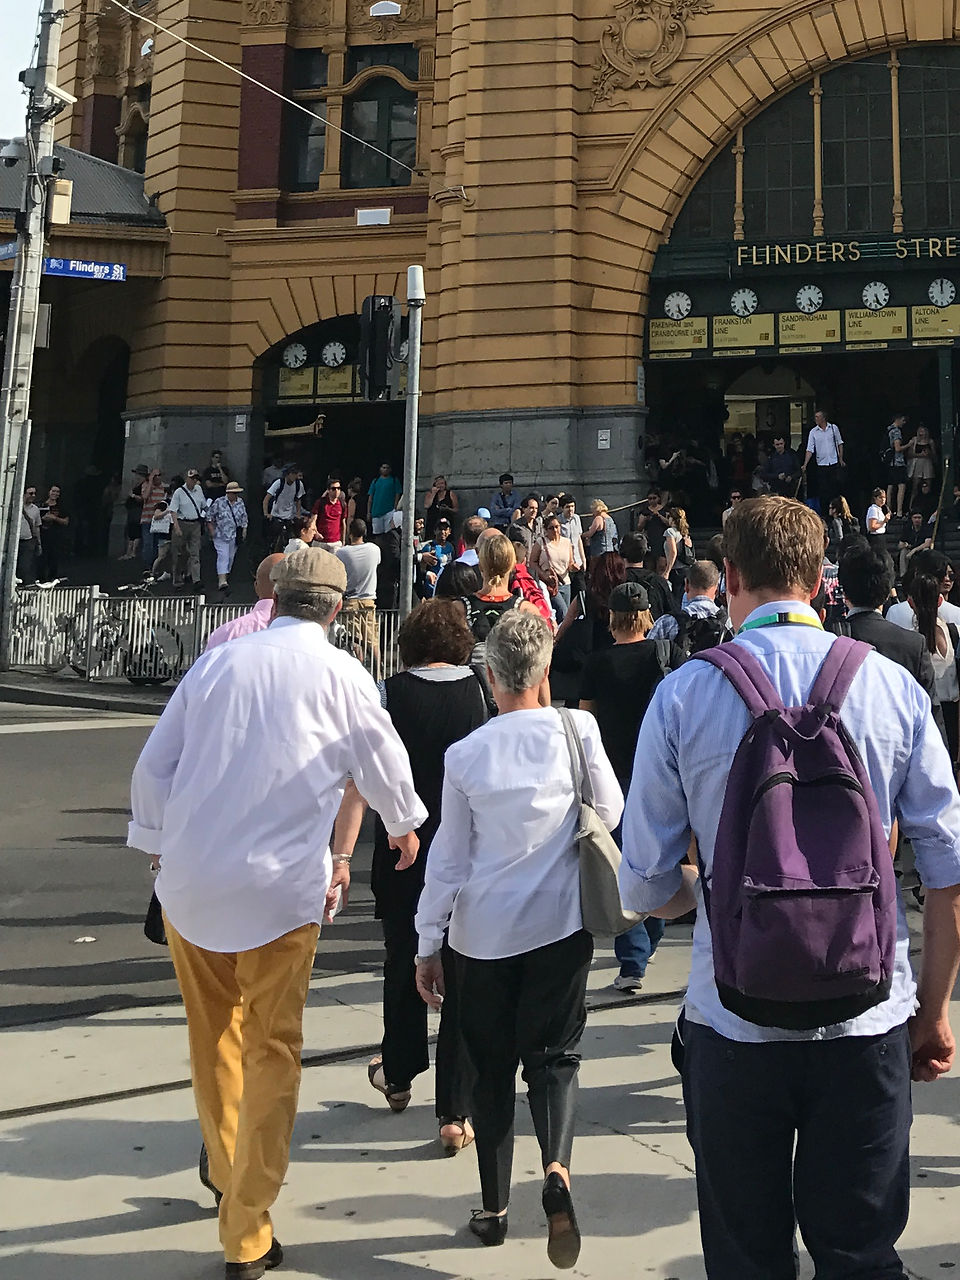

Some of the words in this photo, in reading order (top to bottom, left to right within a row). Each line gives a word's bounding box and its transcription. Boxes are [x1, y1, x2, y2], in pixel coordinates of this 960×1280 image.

[737, 241, 861, 266] FLINDERS
[70, 260, 110, 274] Flinders
[113, 264, 124, 274] St
[781, 314, 827, 322] SANDRINGHAM
[848, 310, 896, 318] WILLIAMSTOWN
[848, 320, 862, 328] LINE
